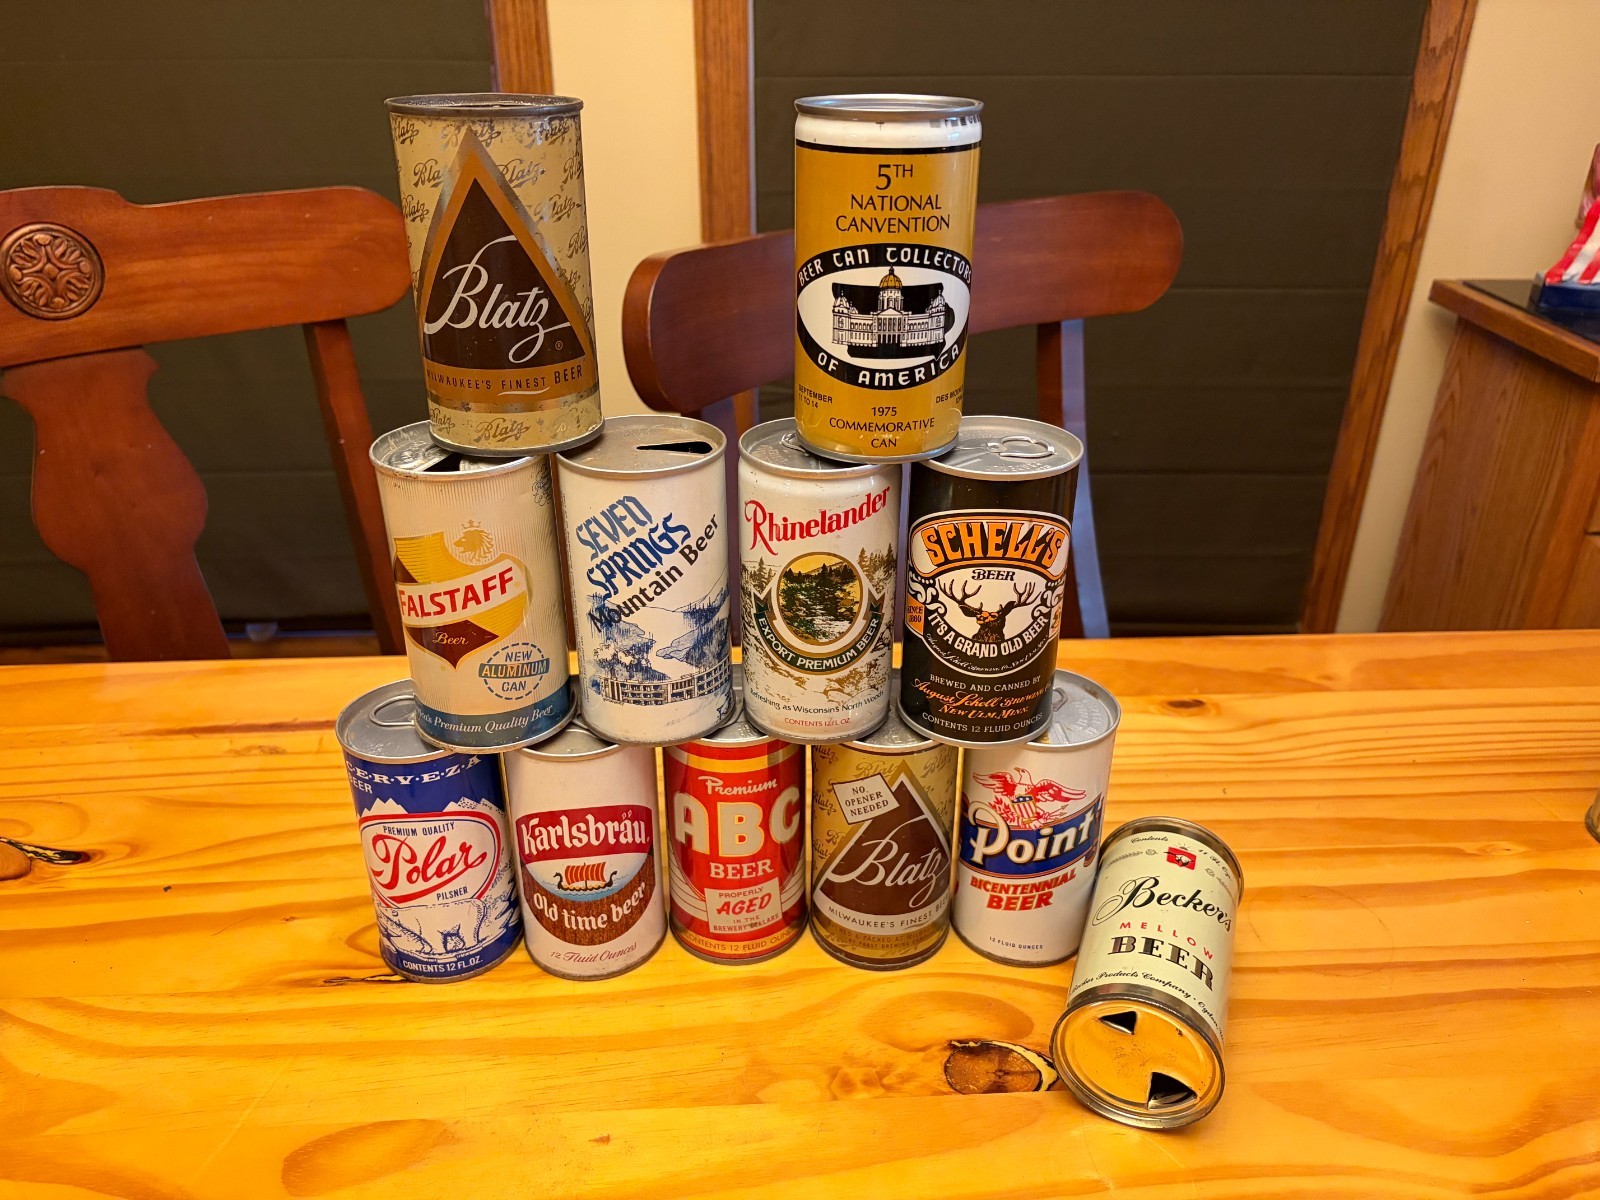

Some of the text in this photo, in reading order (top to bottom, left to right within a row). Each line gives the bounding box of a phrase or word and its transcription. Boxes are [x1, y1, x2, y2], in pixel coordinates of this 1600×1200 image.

[412, 158, 446, 188] Bla
[851, 193, 942, 212] NATIONAL
[836, 213, 951, 233] CANVENTION
[799, 247, 972, 287] BEER CAN COLLECTORS
[424, 235, 571, 364] Blatz
[817, 344, 959, 387] OF AMERICA
[501, 376, 546, 390] FINEST
[554, 364, 583, 384] BEER
[936, 393, 949, 404] DES
[871, 407, 897, 418] 1975
[473, 417, 530, 443] Blatz
[829, 417, 935, 433] COMMEMORATIVE
[871, 438, 898, 449] CAN
[576, 495, 654, 562] SEVEN
[744, 486, 890, 556] Rhinelander
[921, 521, 1066, 567] SCHELL'S
[587, 512, 692, 600] SPRINGS
[587, 514, 719, 633] Mountain Beer
[971, 569, 1015, 581] BEER
[399, 566, 513, 618] FALSTAFF
[432, 631, 470, 645] Beer
[758, 617, 879, 670] EXPORT PREMIUM BEER
[928, 612, 948, 636] IT'S
[943, 630, 956, 645] A
[954, 636, 999, 658] GRAND
[1000, 636, 1023, 656] OLD
[1022, 615, 1049, 644] BEER
[505, 650, 533, 663] NEW
[481, 661, 548, 678] ALUMINUM
[501, 680, 527, 692] CAN
[910, 678, 956, 704] August
[930, 673, 967, 690] BREWED
[970, 684, 991, 692] AND
[993, 679, 1031, 692] CANNED
[1032, 675, 1041, 685] BY
[792, 703, 840, 714] Wisconsin's
[841, 699, 863, 712] North
[434, 705, 553, 734] Premium Quality Beer
[784, 717, 823, 727] CONTENTS
[922, 711, 1043, 733] CONTENTS 12 FLUID OUNCES
[697, 775, 778, 796] Premium
[844, 790, 884, 807] OPENER
[849, 799, 889, 817] NEEDED
[383, 821, 456, 837] PREMIUM QUALITY
[673, 784, 800, 858] ABC
[520, 809, 649, 856] Karlsbräu
[968, 801, 1094, 865] Point
[370, 833, 488, 898] Polar
[709, 859, 775, 880] BEER
[827, 815, 950, 908] Blatz
[970, 867, 1077, 895] BICENTENNIAL
[436, 885, 469, 901] PILSNER
[718, 886, 764, 899] PROPERLY
[986, 890, 1053, 912] BEER
[1092, 875, 1232, 932] Becker's
[533, 881, 646, 931] Old time beer
[716, 892, 772, 916] AGED
[713, 924, 747, 932] BREWERY
[828, 906, 895, 928] MILWAUKEE'S
[900, 910, 933, 927] FINEST
[683, 930, 727, 951] CONTENTS
[729, 944, 740, 952] 12
[742, 940, 767, 952] FLUID
[998, 939, 1016, 948] FLUID
[1119, 921, 1213, 960] MELLOW
[551, 942, 638, 963] 12 Fluid Ounces
[1107, 935, 1214, 992] BEER
[402, 960, 445, 973] CONTENTS
[446, 963, 456, 972] 12
[1096, 970, 1139, 981] Products
[1141, 971, 1192, 998] Company
